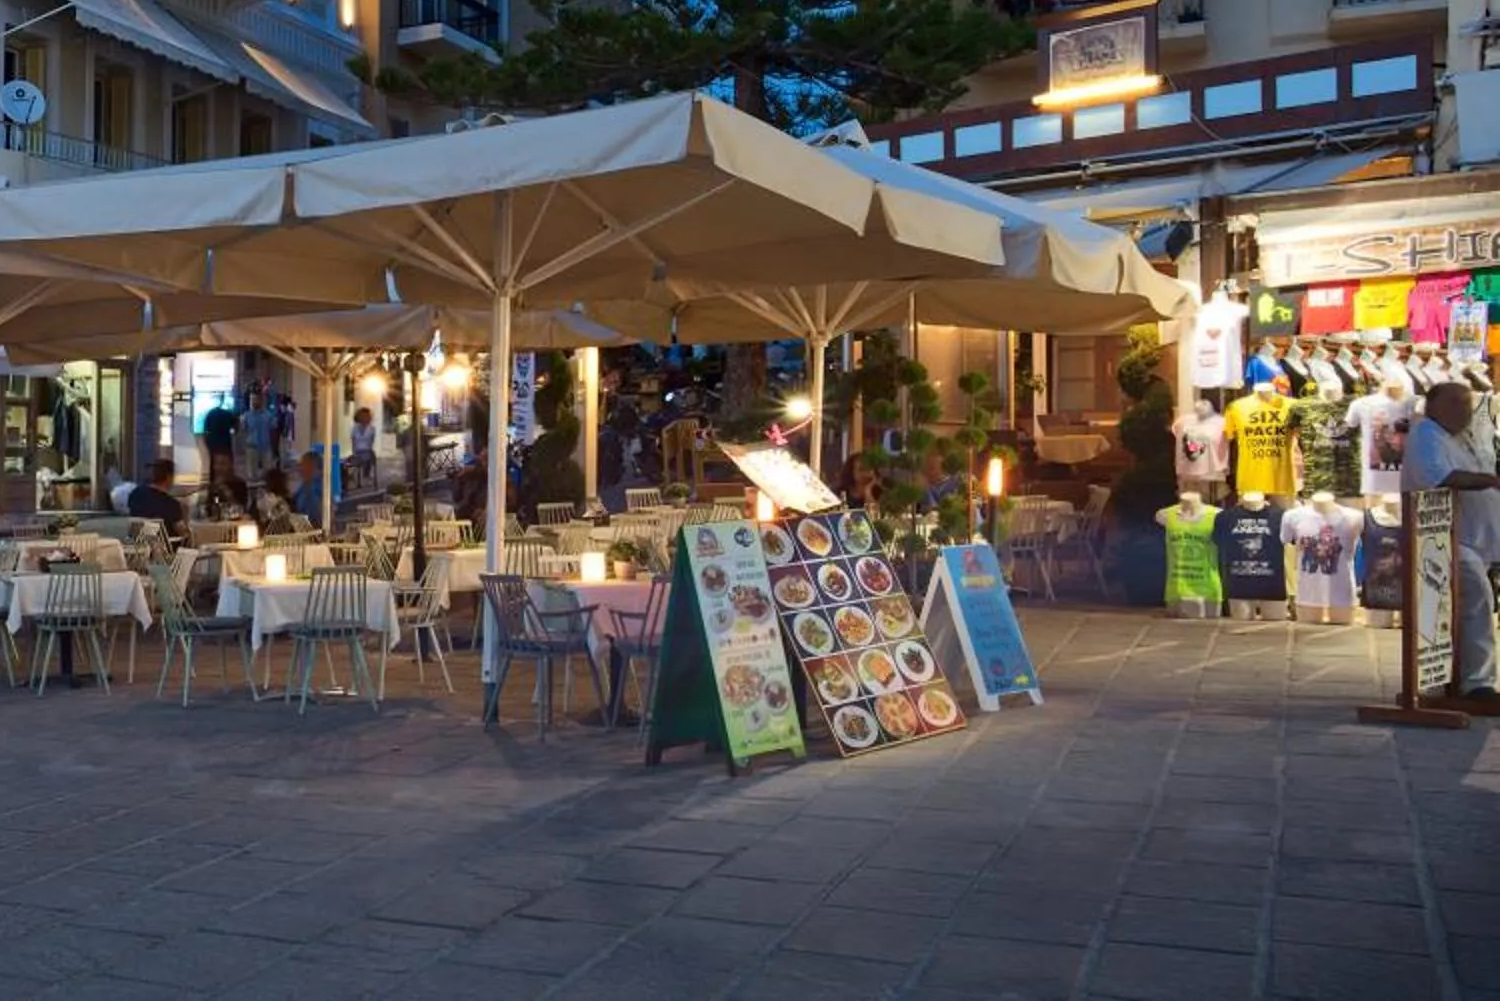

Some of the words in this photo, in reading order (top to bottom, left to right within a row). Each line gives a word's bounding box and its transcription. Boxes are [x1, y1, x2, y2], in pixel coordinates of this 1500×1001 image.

[1249, 410, 1281, 424] SIX
[1244, 425, 1286, 436] PACK
[1246, 437, 1288, 449] COMING
[1251, 448, 1281, 460] SOON
